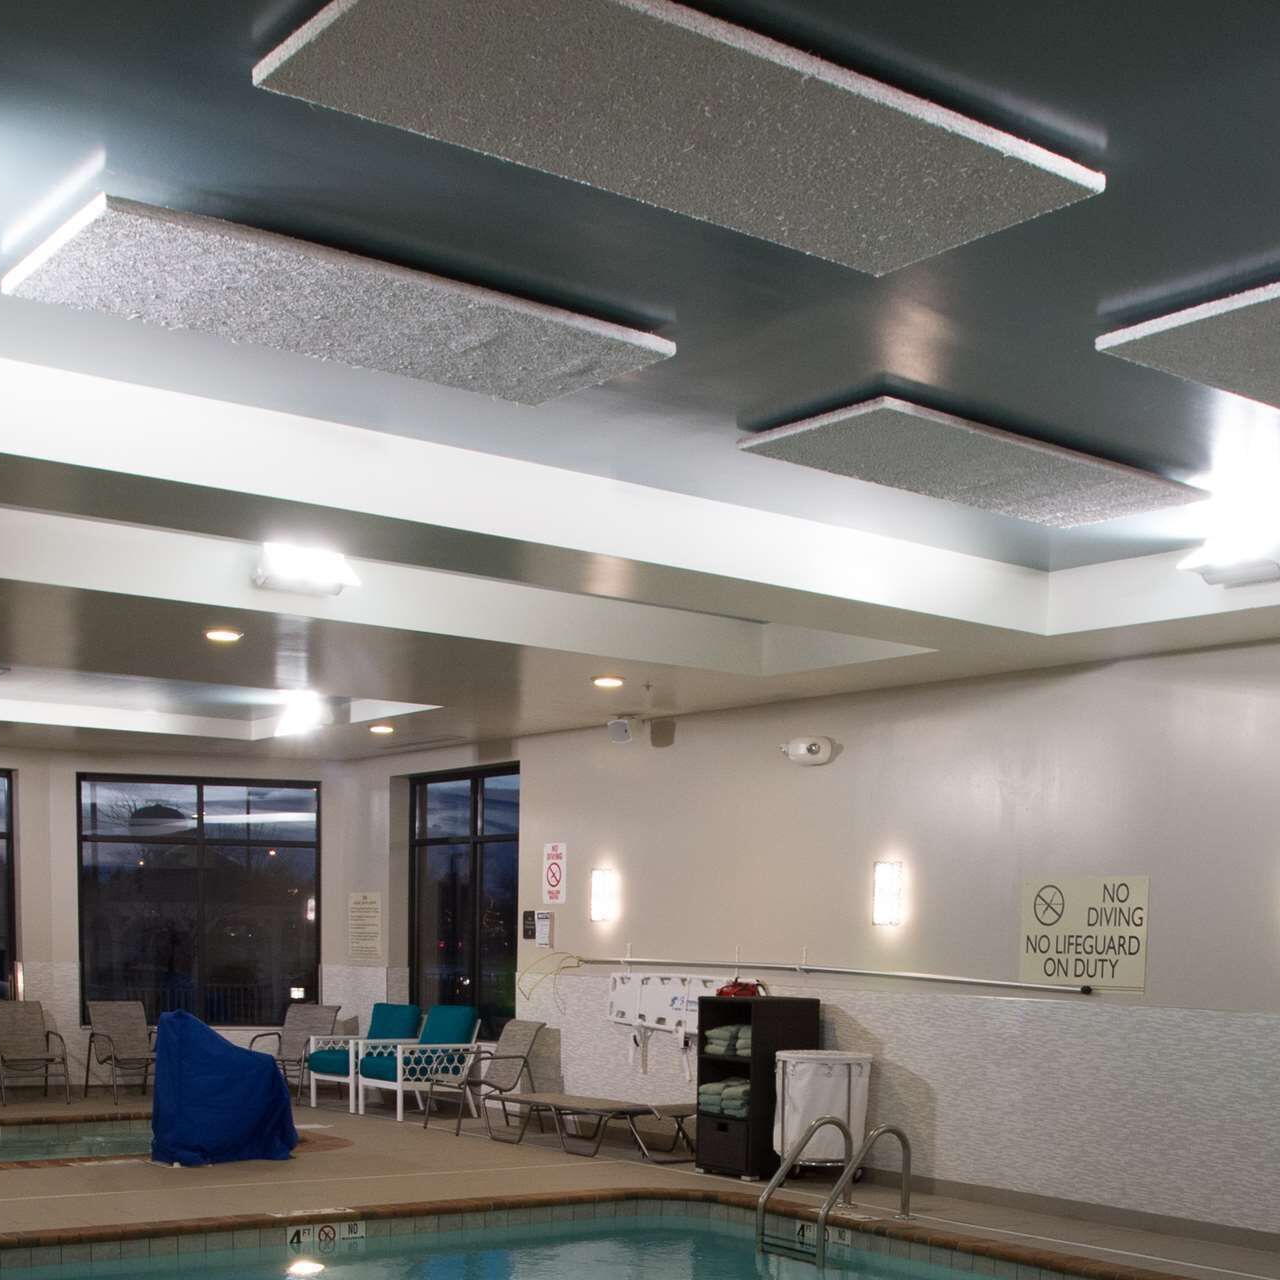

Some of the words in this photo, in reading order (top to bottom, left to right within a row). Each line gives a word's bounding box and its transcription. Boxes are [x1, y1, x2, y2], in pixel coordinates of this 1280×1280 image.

[1102, 882, 1130, 904] NO
[1087, 906, 1144, 927] DIVING
[1026, 934, 1051, 954] NO
[1056, 934, 1141, 956] LIFEGUARD
[1044, 958, 1069, 977] ON
[1074, 958, 1120, 978] DUTY
[290, 1229, 301, 1244] 4
[302, 1228, 311, 1236] FT
[348, 1222, 358, 1234] NO
